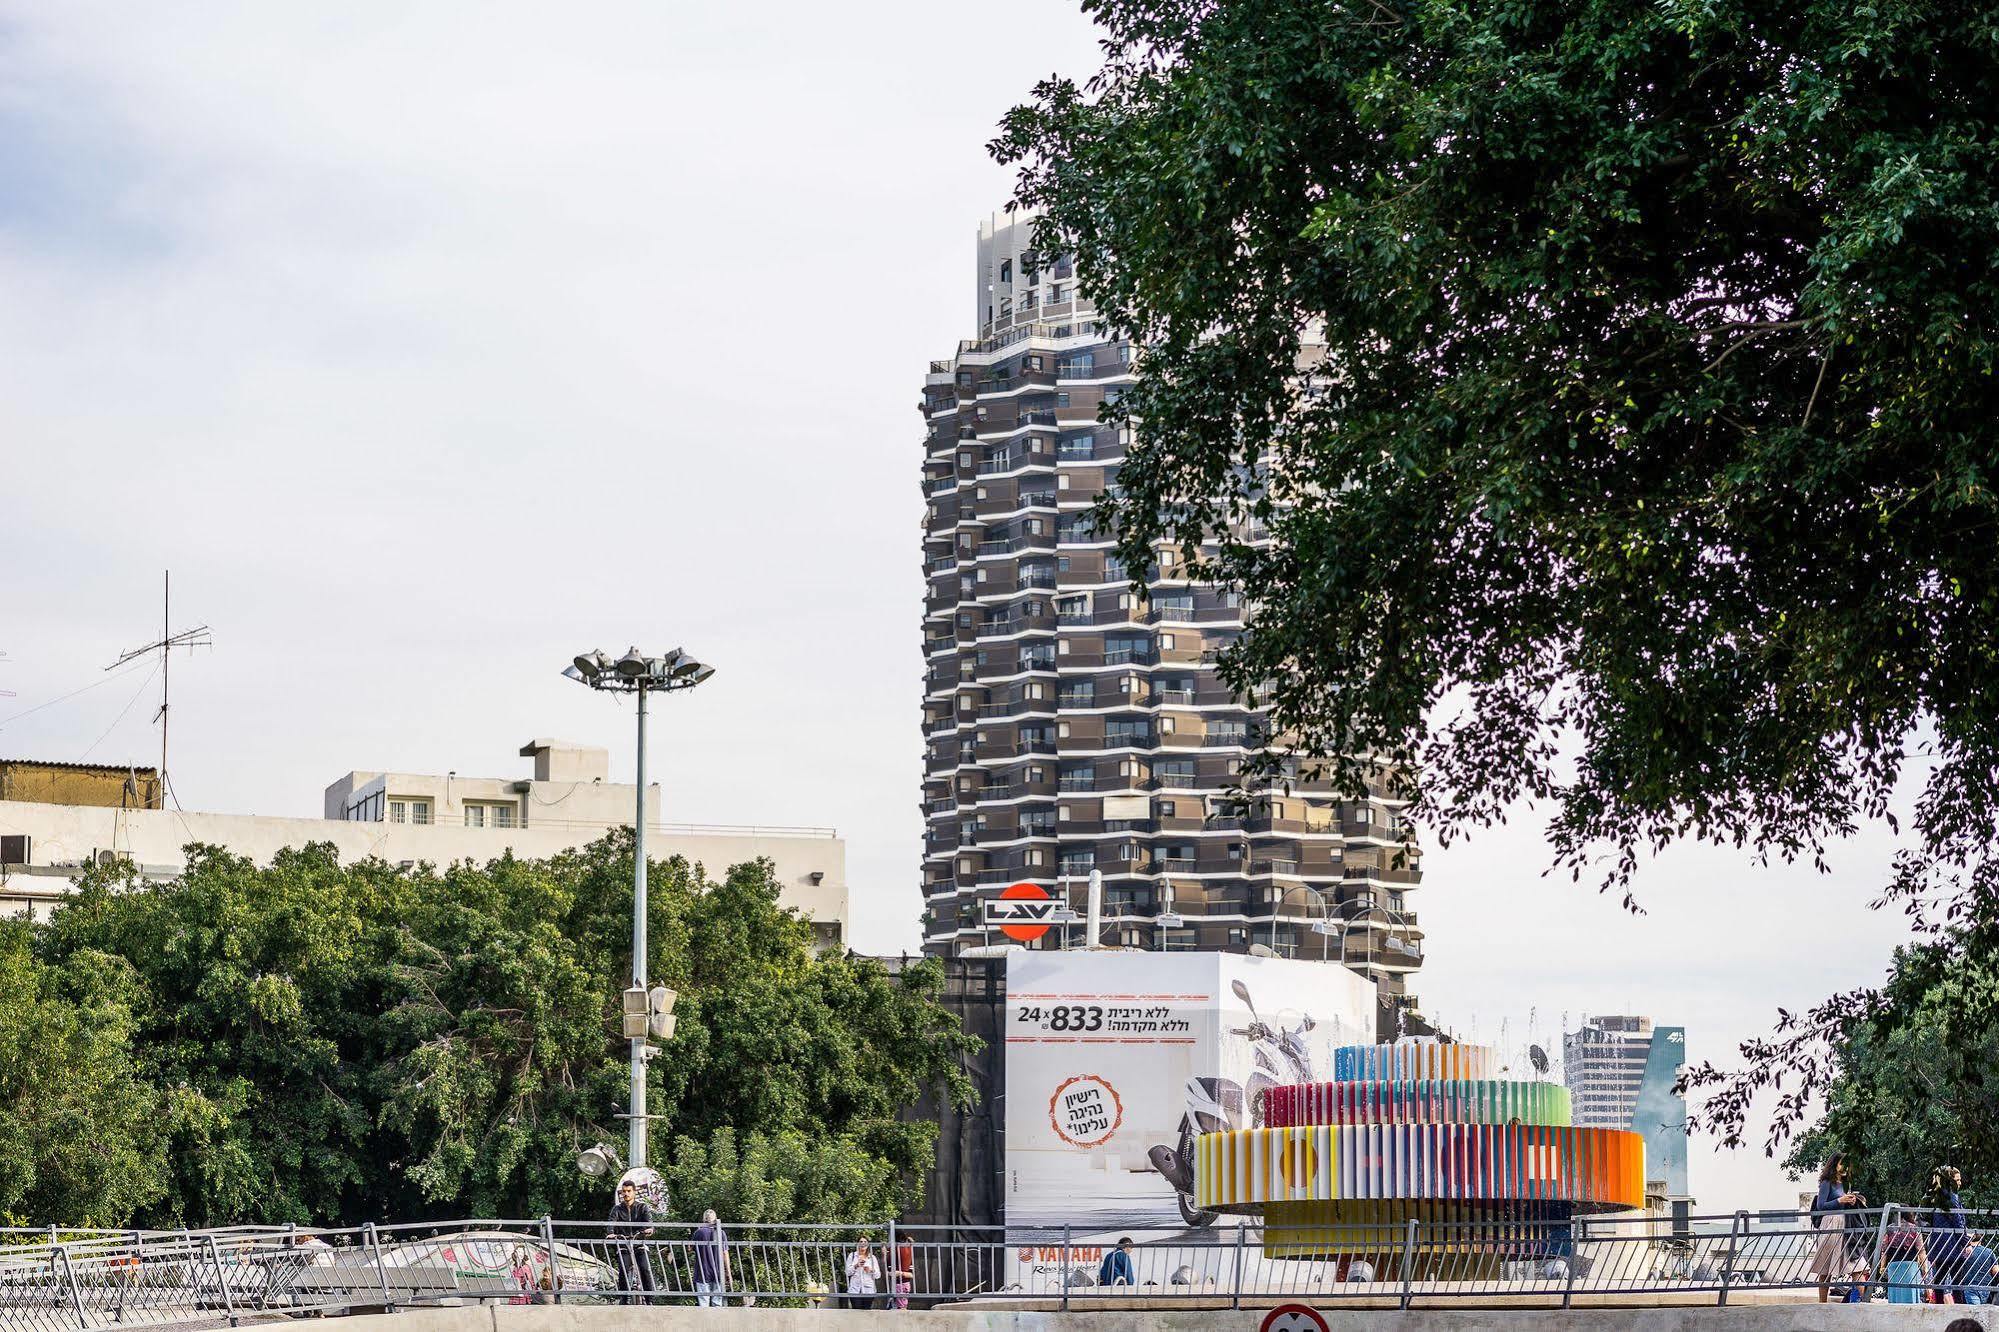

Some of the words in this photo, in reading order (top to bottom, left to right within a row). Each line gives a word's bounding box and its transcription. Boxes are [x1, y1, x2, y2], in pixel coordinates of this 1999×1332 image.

[1018, 1006, 1040, 1022] 24
[1050, 1005, 1103, 1031] 833
[1107, 1007, 1142, 1018] ריבית
[1145, 1006, 1170, 1018] ללא
[1107, 1020, 1157, 1033] מקדמה!
[1160, 1020, 1189, 1031] וללא
[1065, 1089, 1100, 1109] רישיון
[1068, 1103, 1103, 1121] נהיגה
